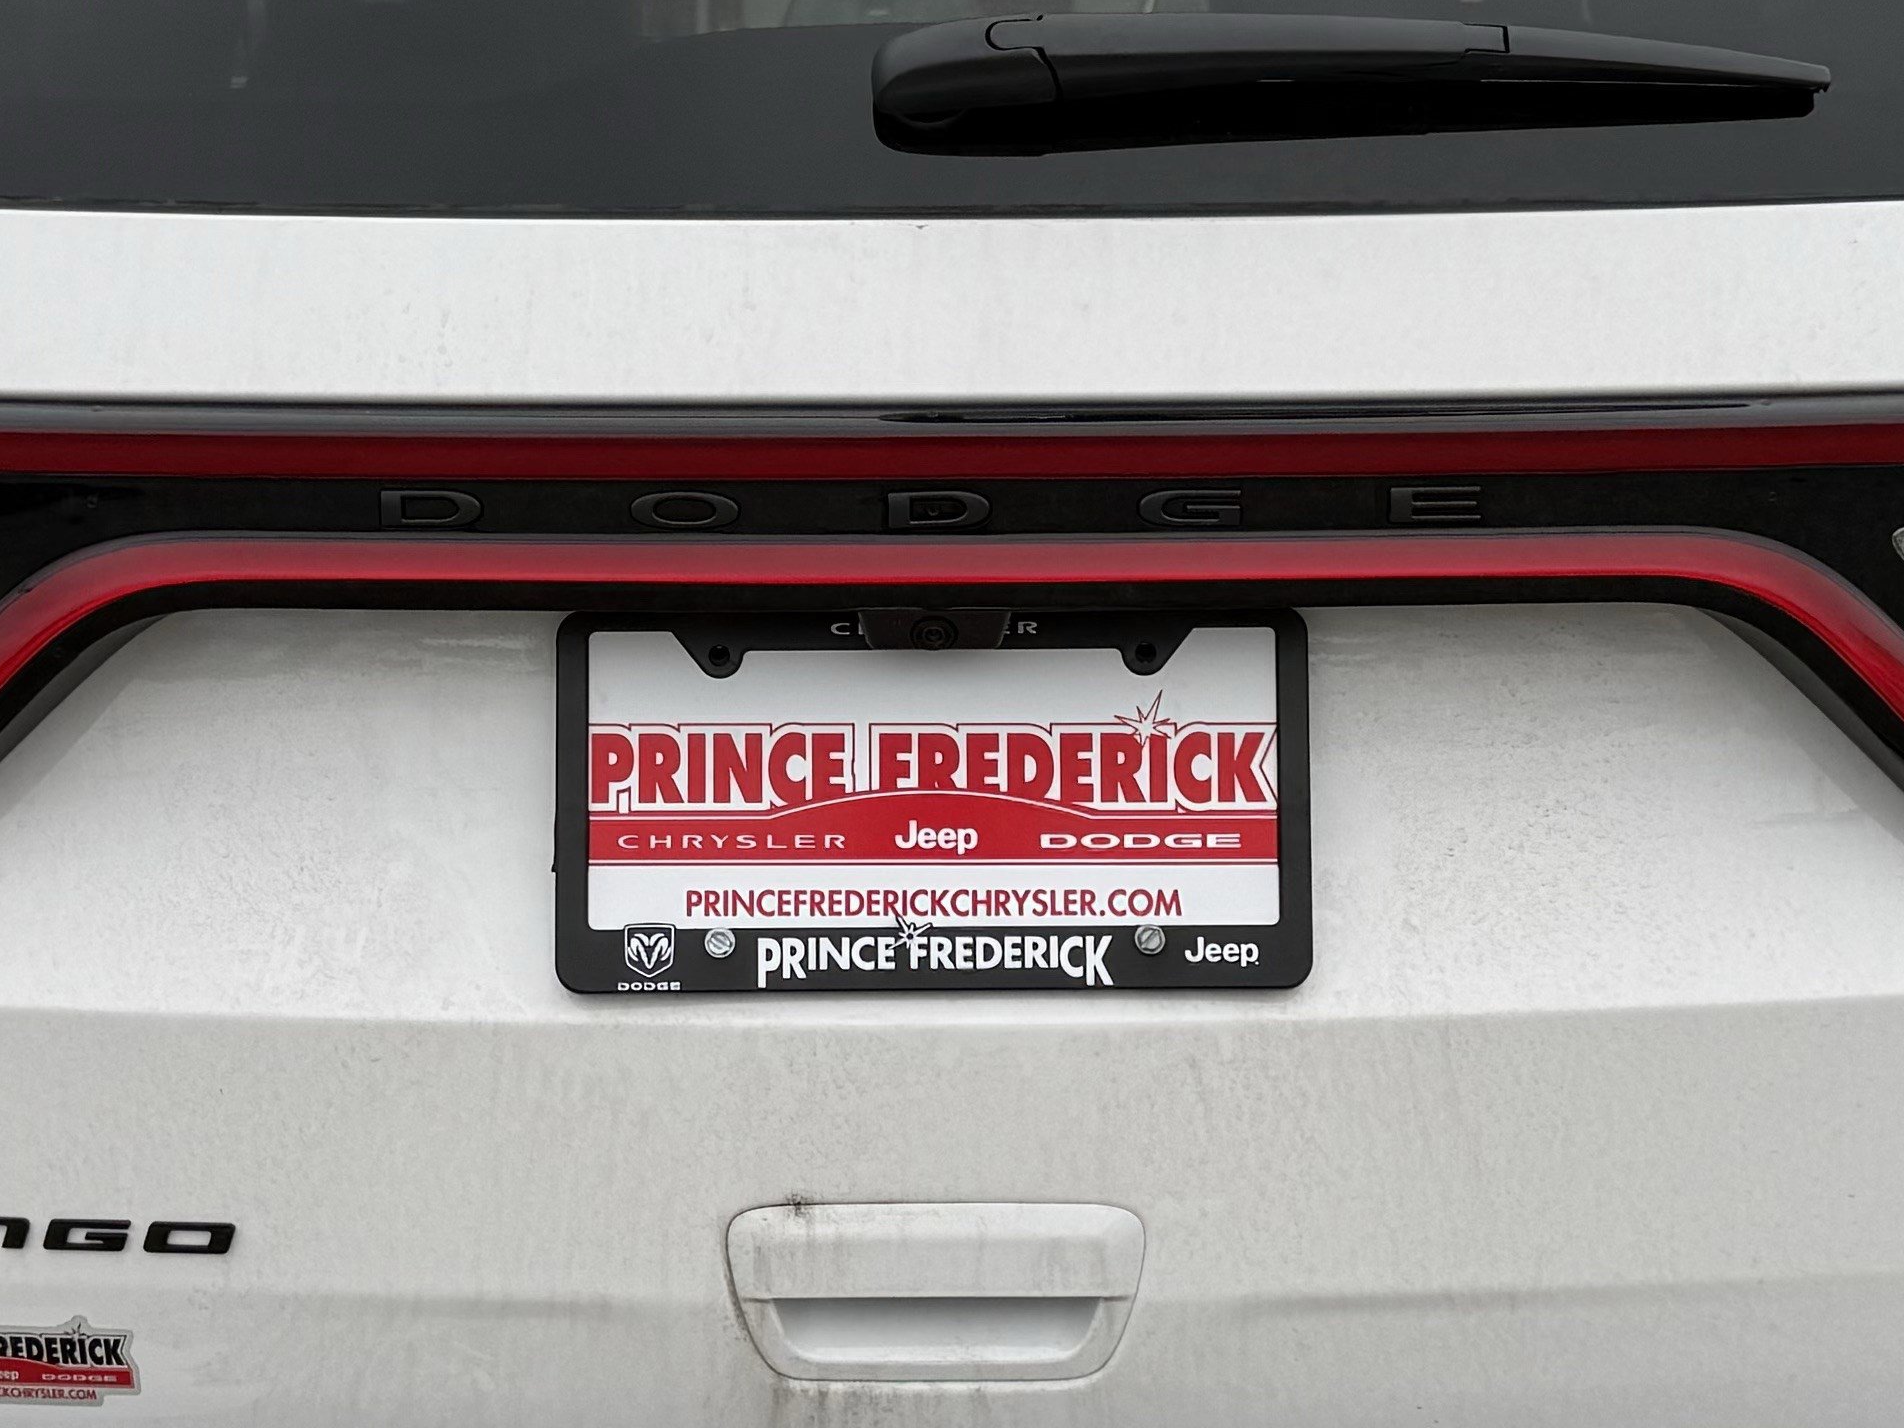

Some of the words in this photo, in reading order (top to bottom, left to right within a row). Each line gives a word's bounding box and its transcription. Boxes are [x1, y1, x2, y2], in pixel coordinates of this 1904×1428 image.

[378, 484, 1483, 531] DODGE
[590, 729, 854, 808] PRINCE
[877, 729, 1270, 808] FREDERICK
[617, 833, 847, 850] CHRYSLER
[895, 818, 979, 856] Jeep
[1039, 833, 1242, 849] DODGE
[685, 888, 1183, 918] PRINCEFREDERICKCHRYSLER.COM
[756, 935, 896, 988] PRINCE
[912, 933, 1114, 985] FREDERICK
[1184, 935, 1260, 967] Jeep
[617, 981, 681, 991] DODGE
[41, 1372, 118, 1383] DODGE
